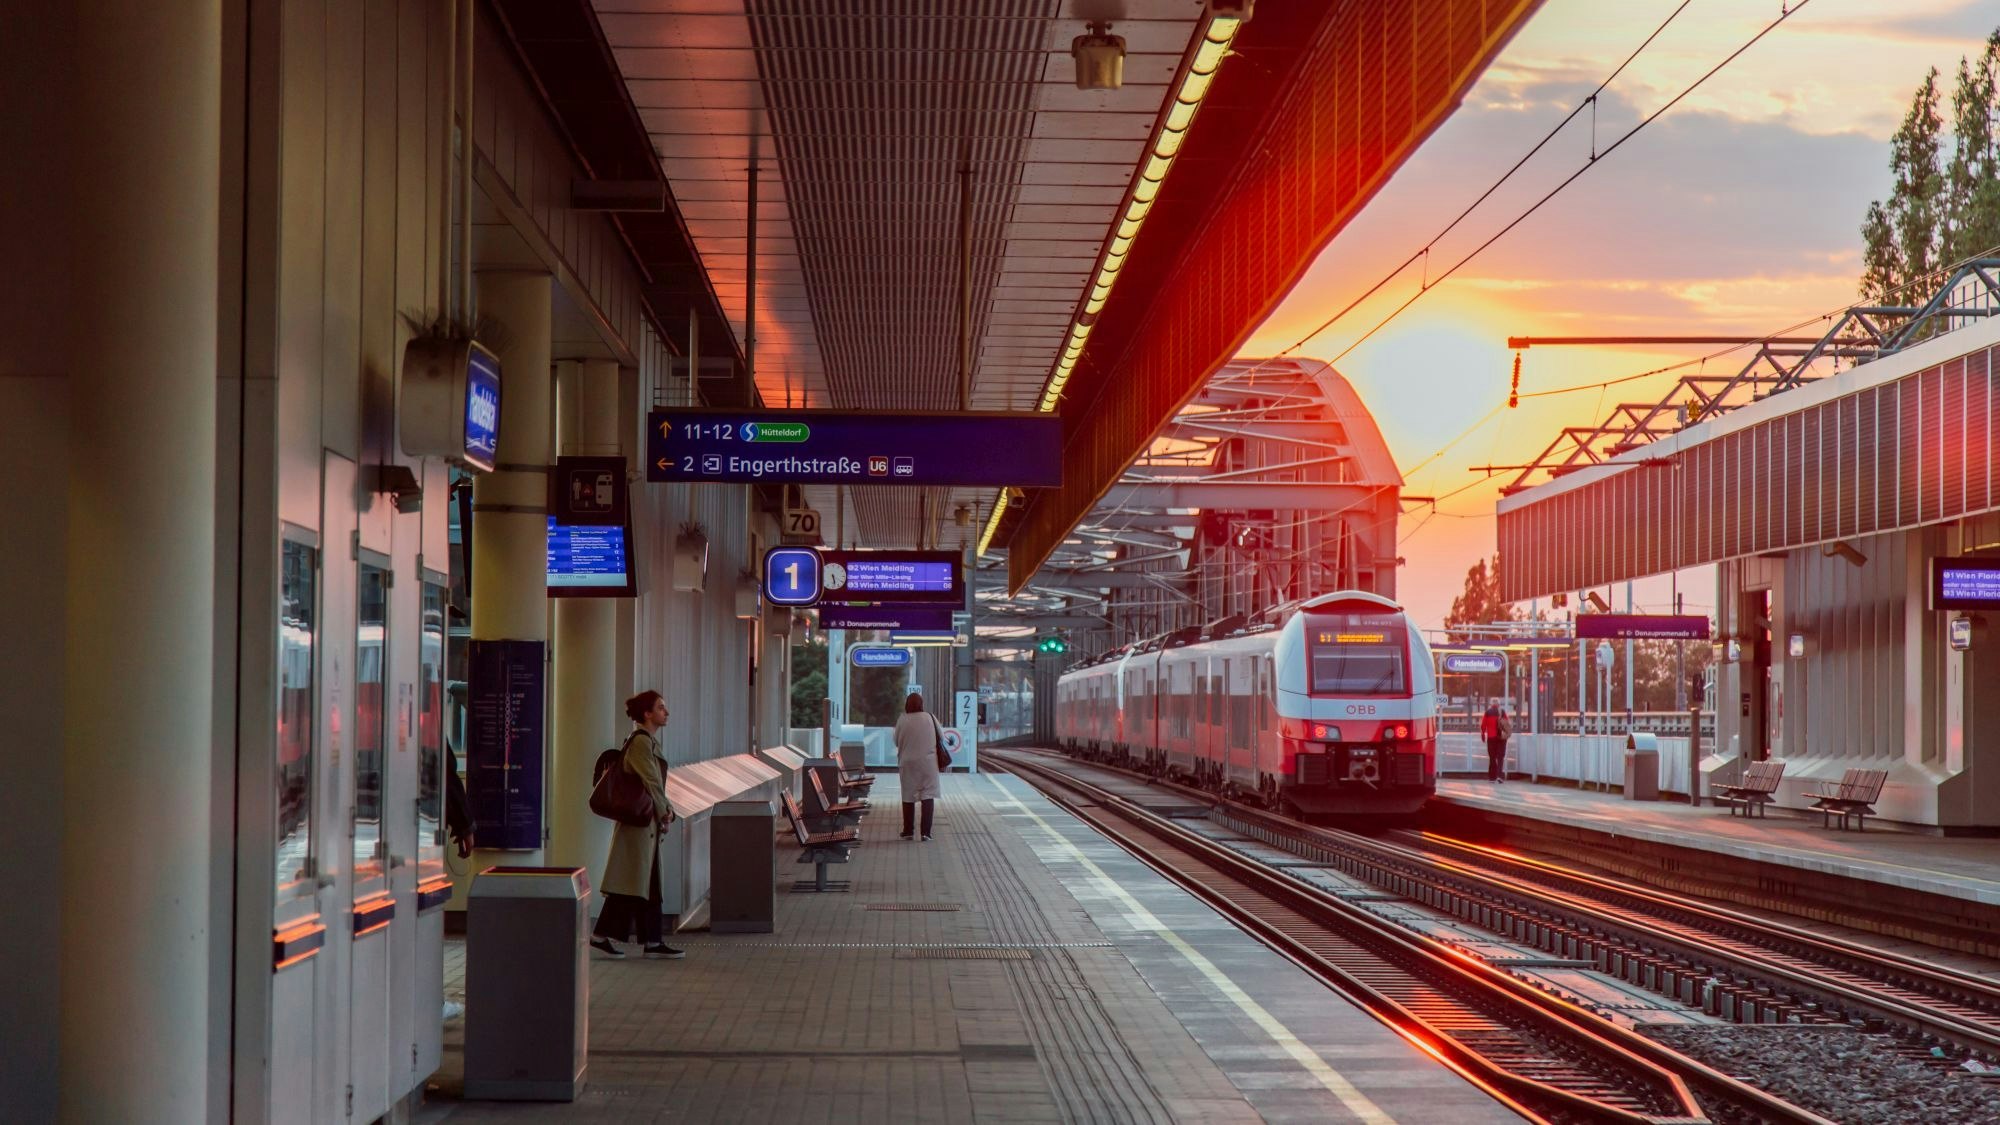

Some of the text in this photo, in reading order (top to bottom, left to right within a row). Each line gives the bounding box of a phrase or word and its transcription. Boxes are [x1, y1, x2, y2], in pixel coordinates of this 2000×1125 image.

[684, 424, 732, 439] 11-12
[761, 428, 801, 437] Hütteldorf
[683, 456, 887, 477] 2 Engerthstraße U6
[789, 513, 815, 532] 70
[881, 565, 915, 573] Meidling
[784, 562, 798, 590] 1
[881, 582, 915, 590] Meidling
[861, 653, 902, 661] Handelskai
[1346, 704, 1376, 715] ÖBB
